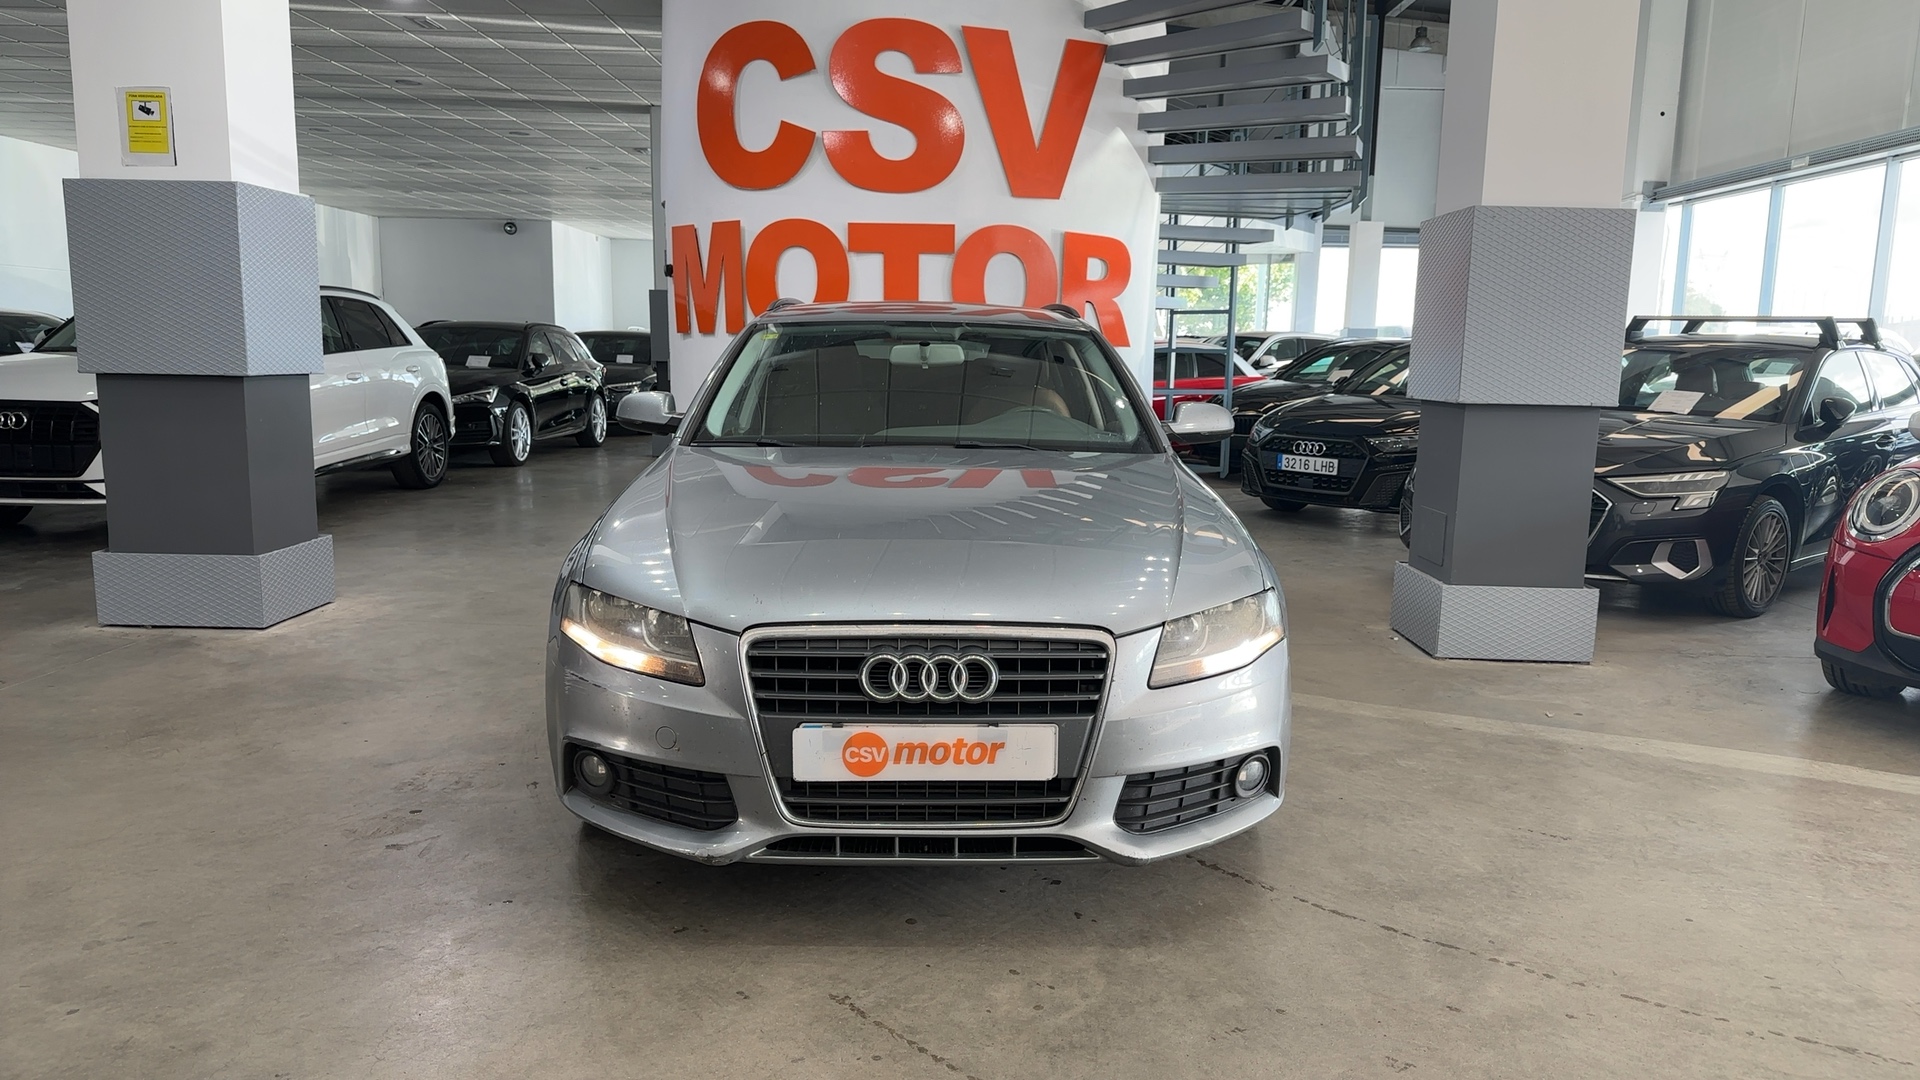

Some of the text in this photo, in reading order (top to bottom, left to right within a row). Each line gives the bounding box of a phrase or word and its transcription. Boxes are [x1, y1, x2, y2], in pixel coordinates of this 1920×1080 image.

[697, 18, 1108, 199] CSV
[672, 218, 1132, 347] MOTOR
[1284, 457, 1335, 473] 3216 LHB
[893, 738, 1006, 766] motor
